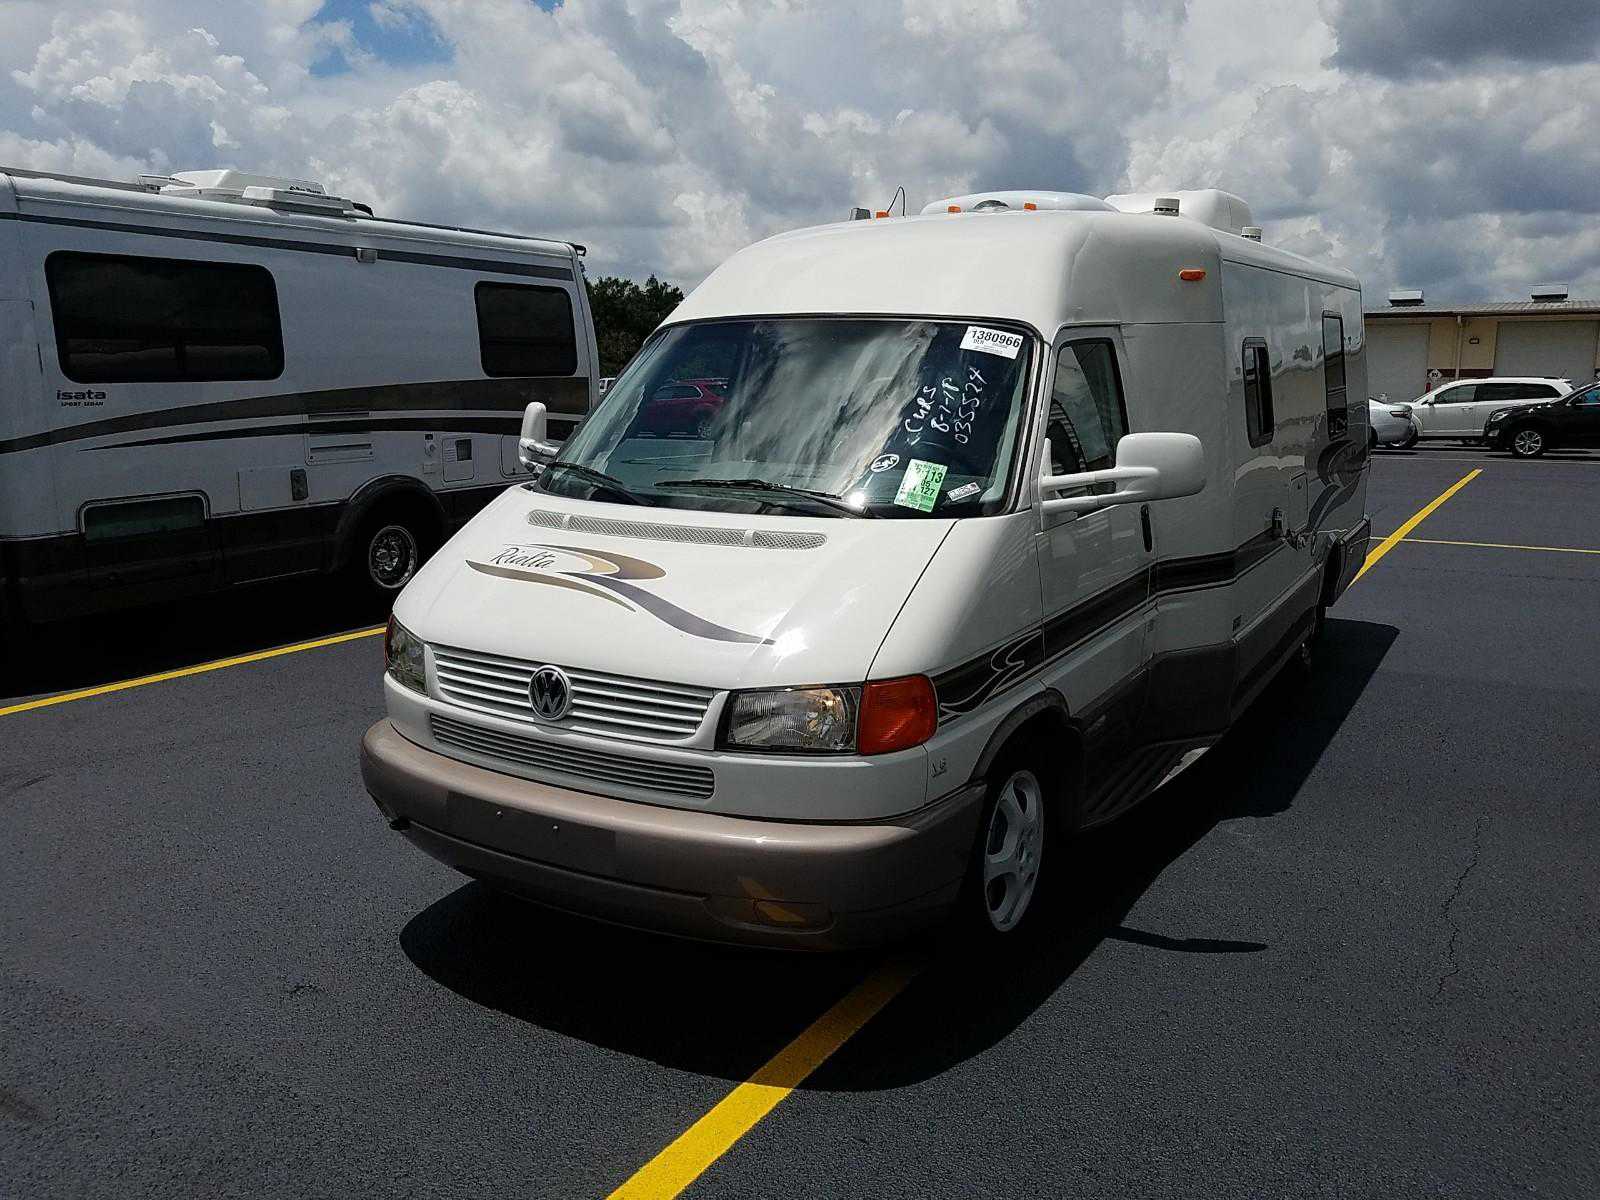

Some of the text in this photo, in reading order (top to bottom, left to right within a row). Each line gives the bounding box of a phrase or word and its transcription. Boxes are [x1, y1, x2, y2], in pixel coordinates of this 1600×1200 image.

[971, 329, 1021, 348] 1380966
[56, 389, 107, 401] isata
[489, 547, 556, 569] Rialta
[529, 667, 569, 717] VW
